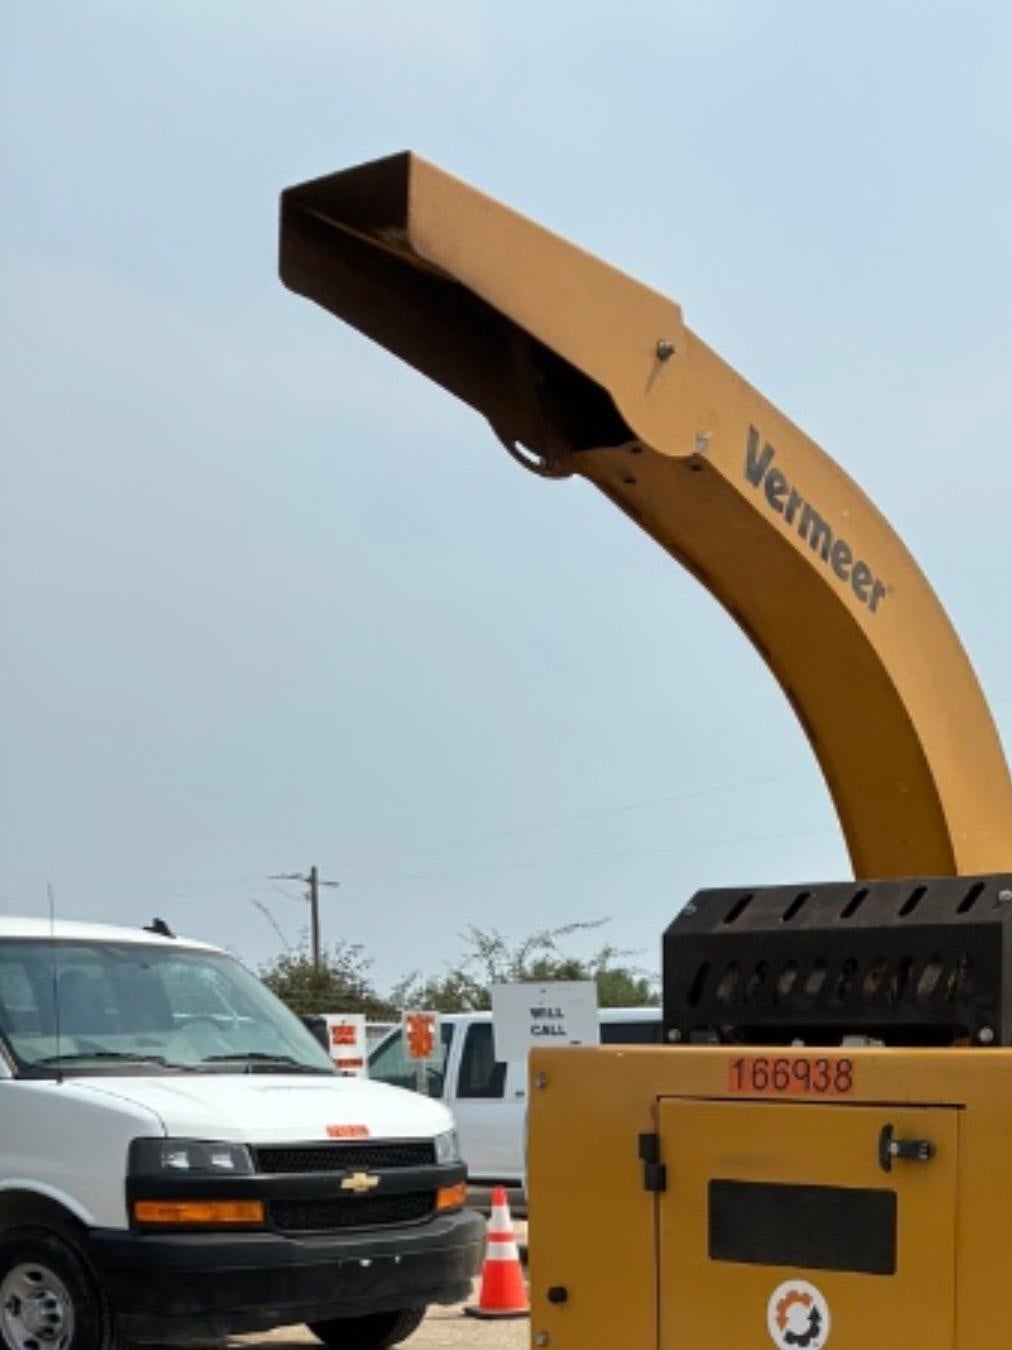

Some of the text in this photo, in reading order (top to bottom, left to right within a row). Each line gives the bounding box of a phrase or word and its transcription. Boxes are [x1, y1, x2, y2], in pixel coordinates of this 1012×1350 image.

[744, 424, 887, 613] Vermeer
[530, 1007, 565, 1019] WILL
[530, 1025, 568, 1036] CALL
[731, 1058, 853, 1093] 166938
